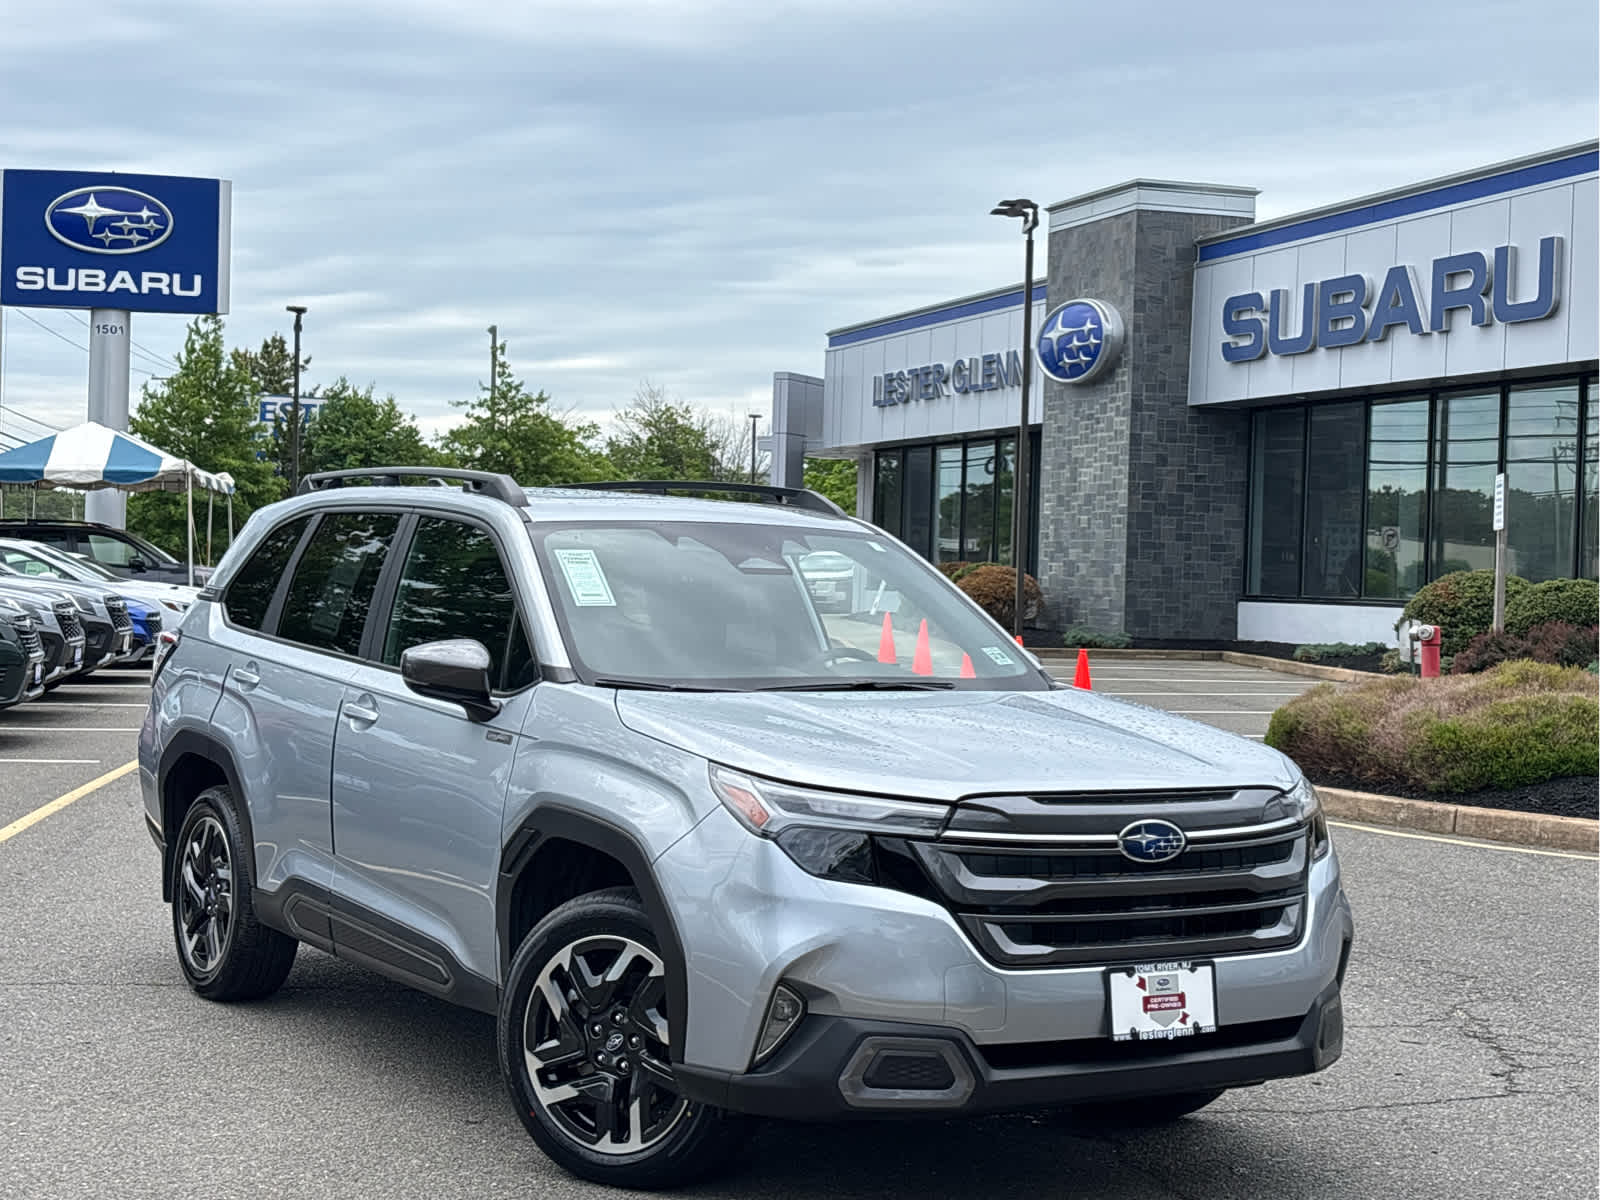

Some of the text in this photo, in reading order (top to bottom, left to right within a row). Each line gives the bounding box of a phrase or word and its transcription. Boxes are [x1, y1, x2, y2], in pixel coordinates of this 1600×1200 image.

[15, 266, 202, 297] SUBARU
[1222, 235, 1564, 364] SUBARU
[95, 324, 125, 335] 1501
[872, 350, 1024, 408] LESTER GLENN
[1135, 963, 1155, 973] TOMS
[1182, 960, 1191, 969] NJ
[1147, 1001, 1182, 1009] PRE-OWNED
